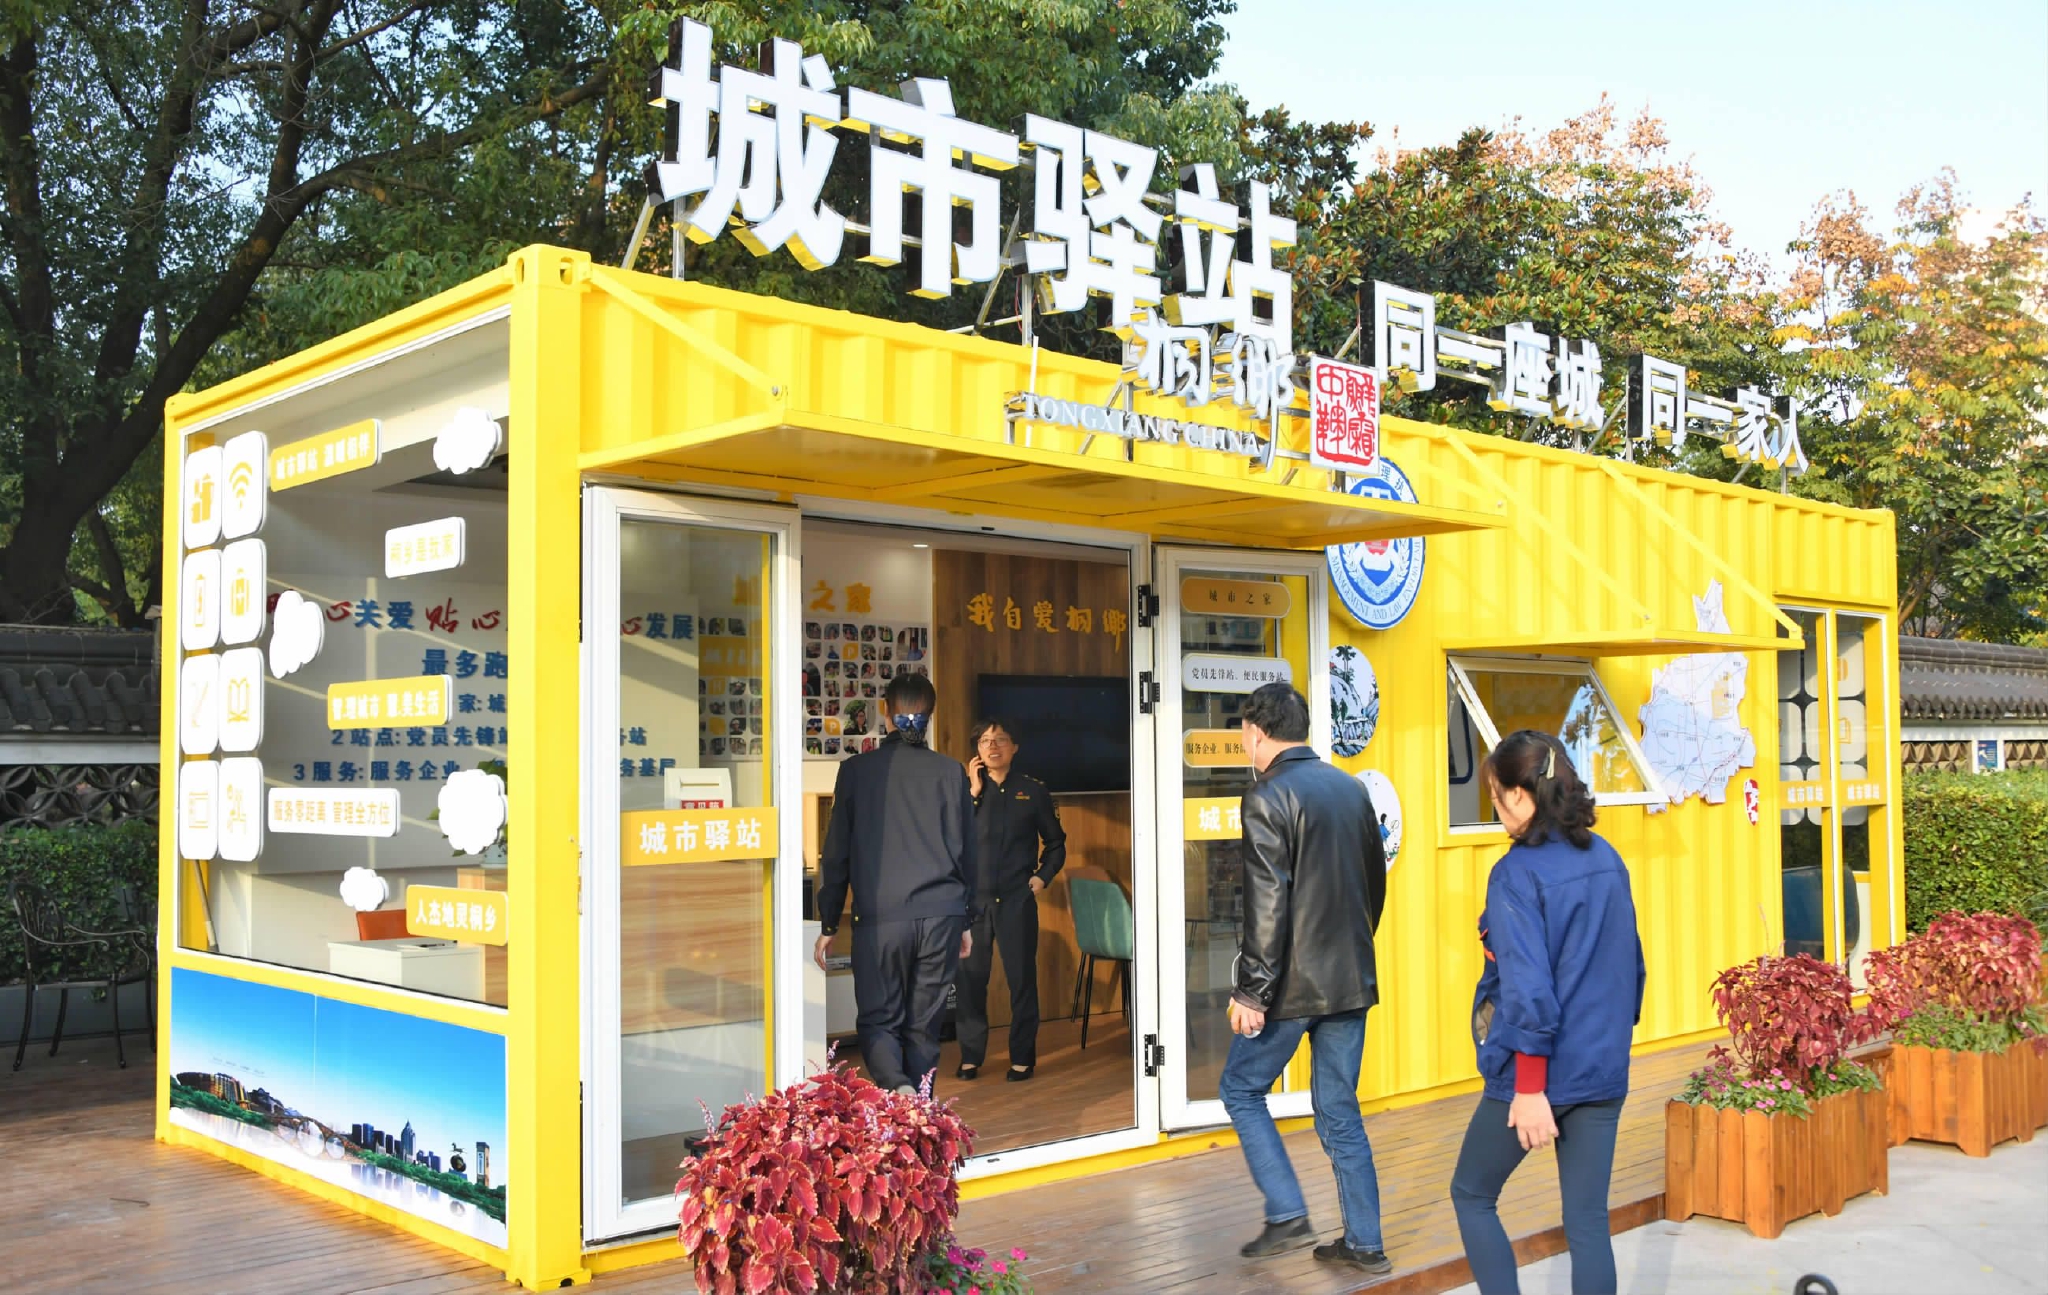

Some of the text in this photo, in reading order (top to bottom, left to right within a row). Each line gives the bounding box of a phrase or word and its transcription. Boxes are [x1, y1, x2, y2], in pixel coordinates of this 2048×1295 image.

[657, 16, 1297, 350] 城市驿站
[1374, 280, 1604, 430] 同一座城
[1642, 354, 1809, 474] 同一家人
[1023, 392, 1263, 458] TONGXIANG CHINA
[1208, 589, 1272, 606] 城市之家
[1185, 742, 1246, 755] 服务企业、服务
[274, 800, 391, 825] 服务零距离 管理全方位
[639, 818, 762, 856] 城市驿站
[415, 899, 497, 932] 人杰地灵桐乡
